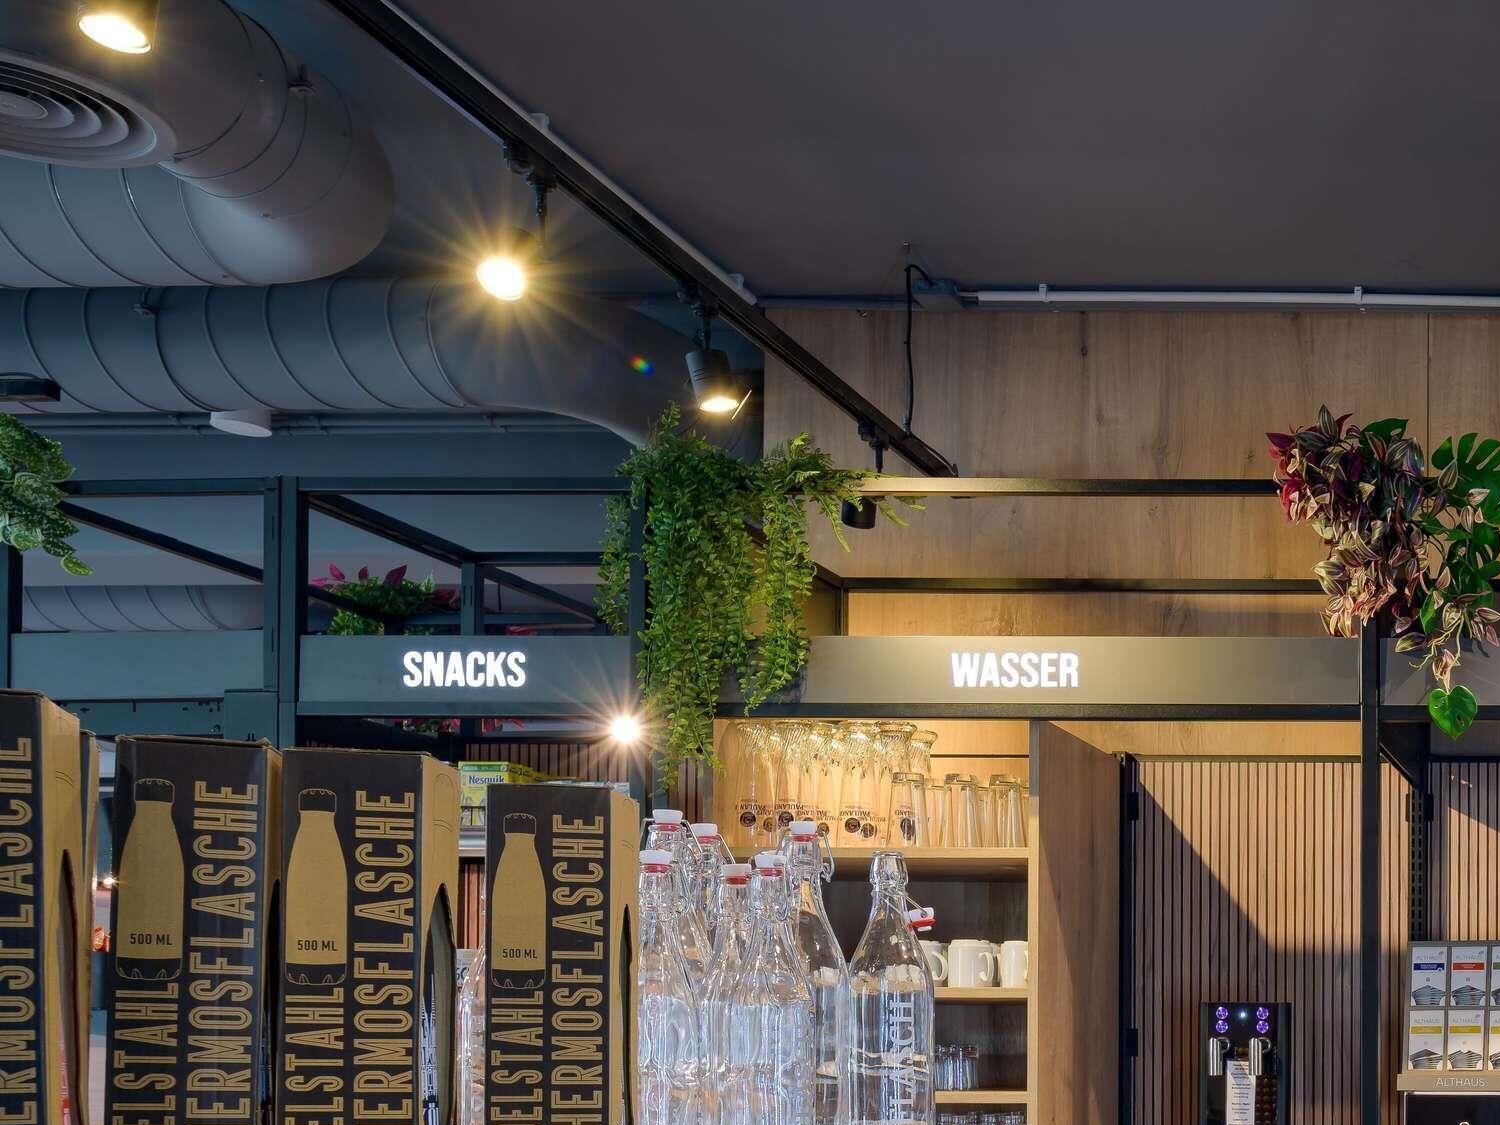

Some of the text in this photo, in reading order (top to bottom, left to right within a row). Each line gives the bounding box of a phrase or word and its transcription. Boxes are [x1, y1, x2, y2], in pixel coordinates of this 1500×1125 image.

[403, 651, 526, 687] SNACKS
[951, 652, 1079, 688] WASSER
[469, 775, 504, 784] Nesquik
[130, 933, 172, 945] 500 ML
[297, 939, 337, 951] 500 ML
[502, 948, 537, 959] 500 ML
[1435, 1077, 1486, 1088] ALTHAUS
